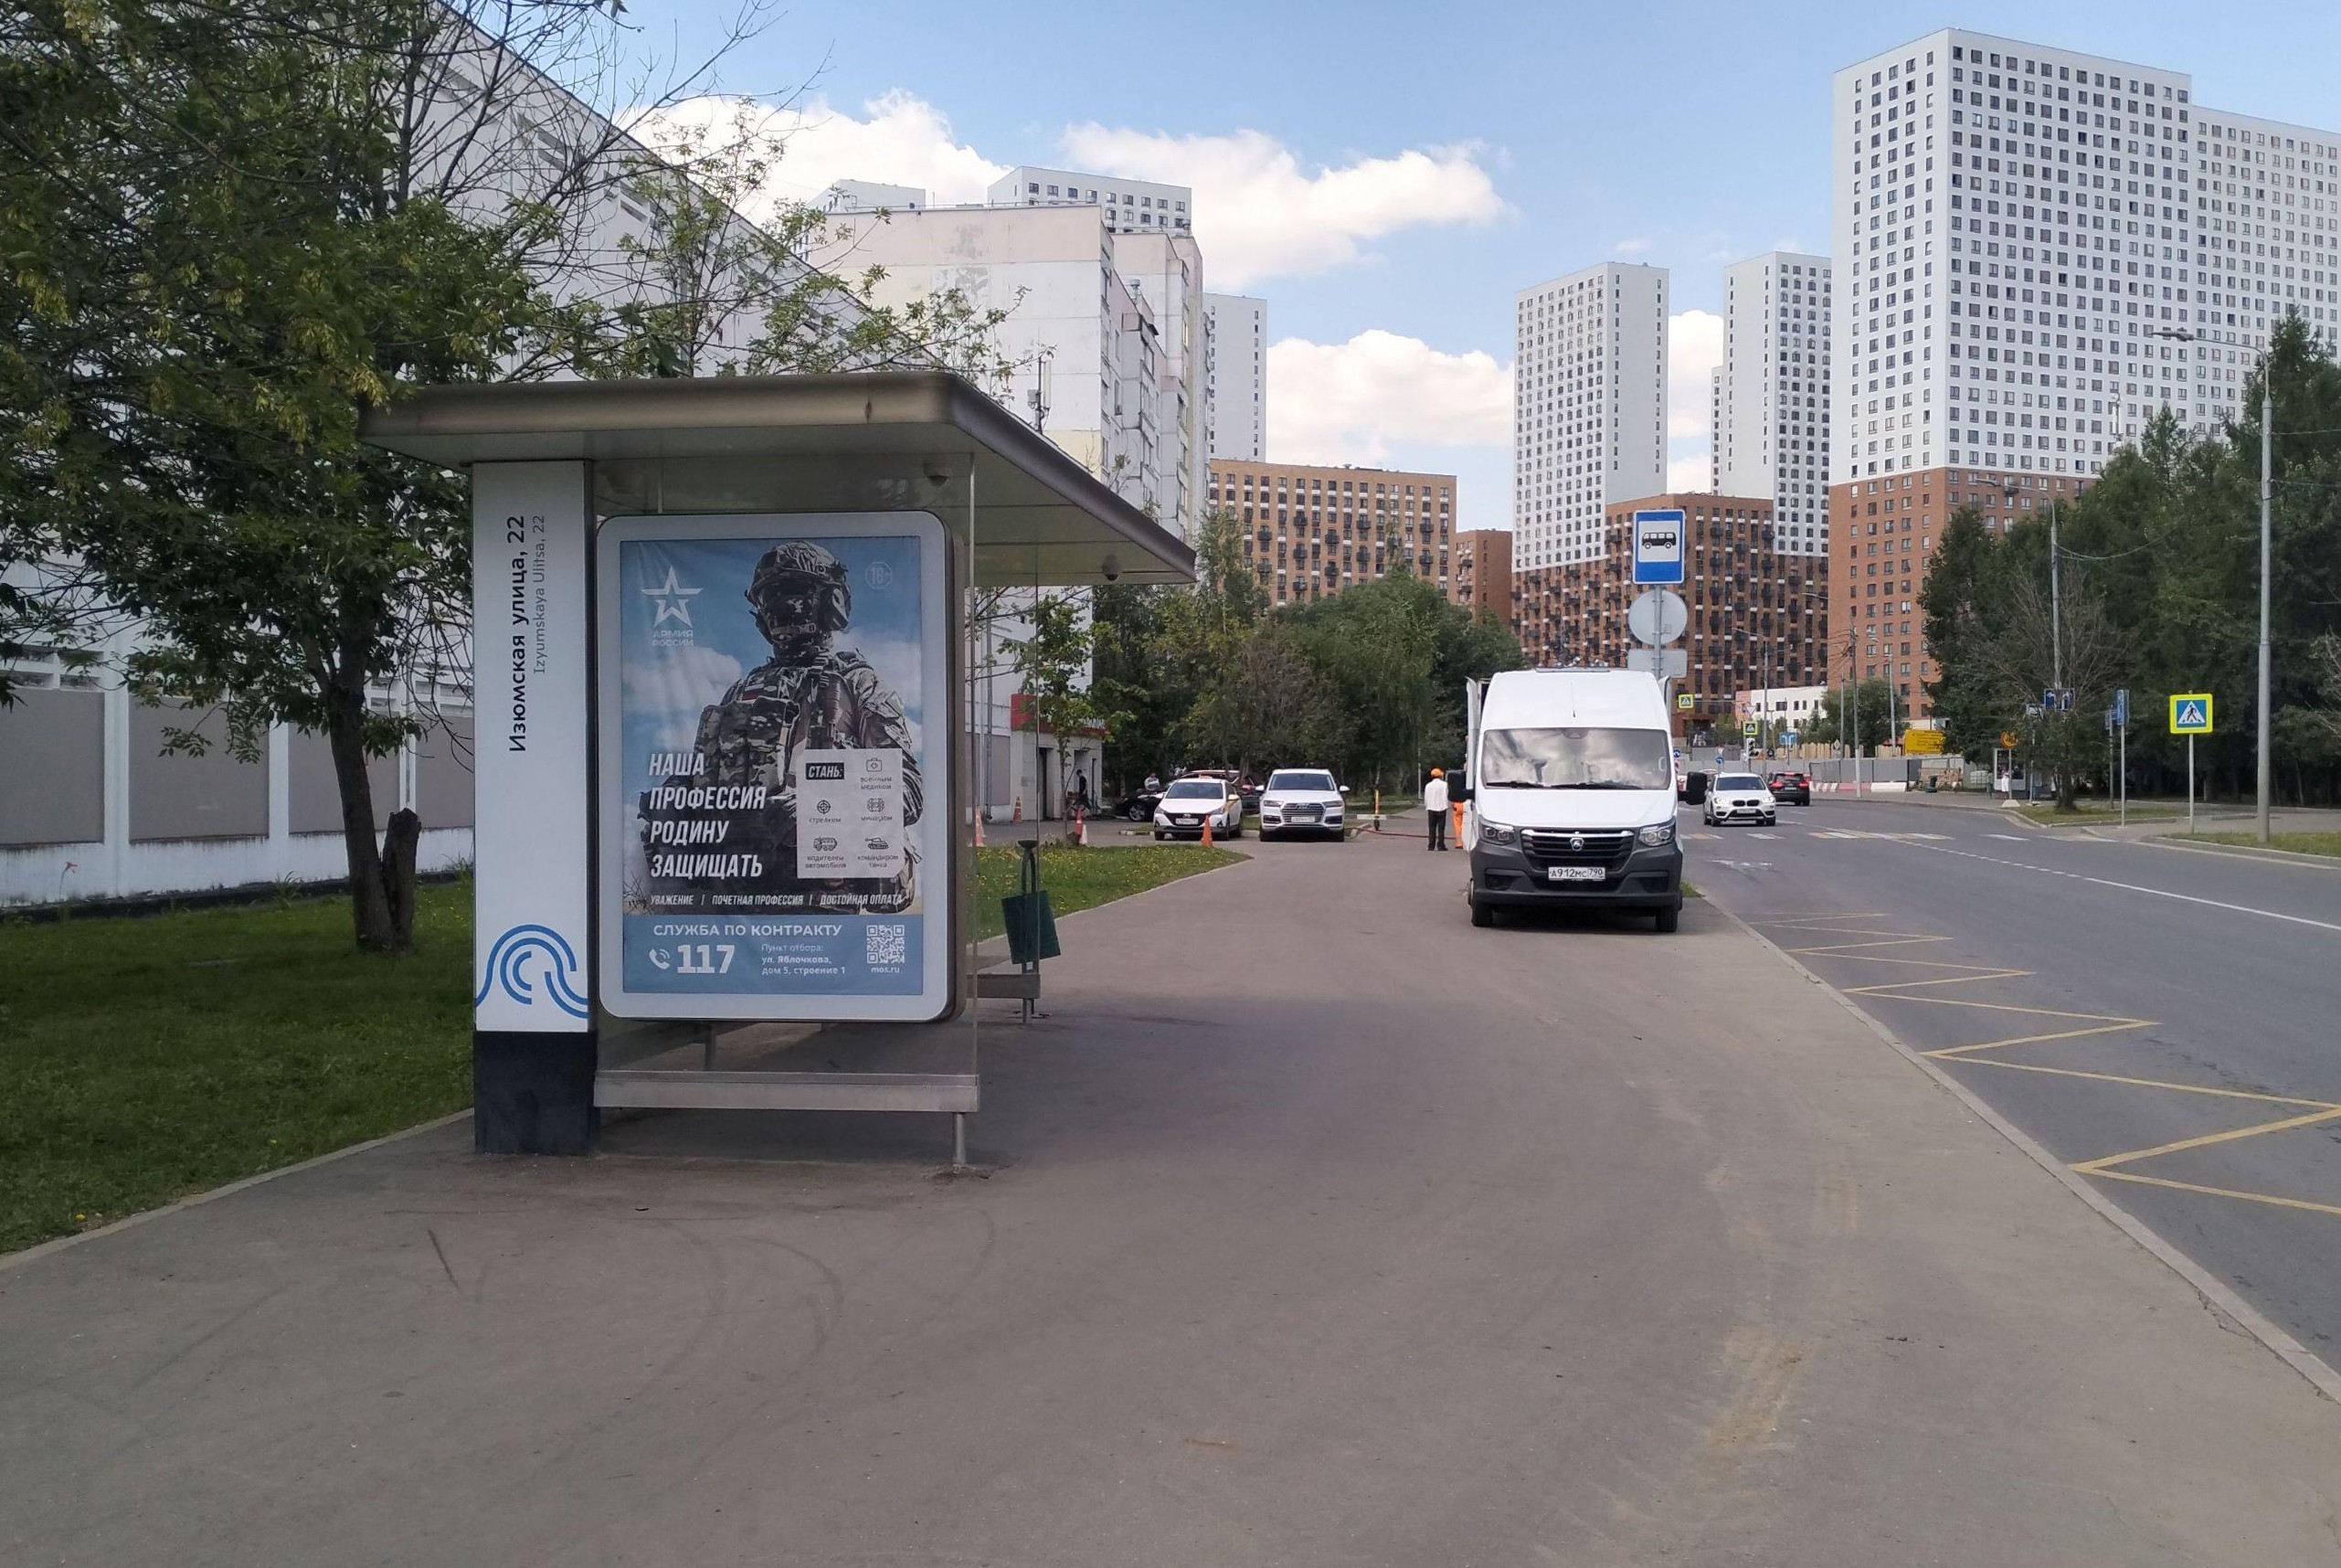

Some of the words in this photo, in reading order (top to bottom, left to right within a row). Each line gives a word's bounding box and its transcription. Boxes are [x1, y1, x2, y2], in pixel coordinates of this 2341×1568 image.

[507, 515, 524, 544] 22
[533, 514, 545, 534] 22
[533, 538, 546, 583] Ulitsa,
[512, 551, 529, 626] улица,
[533, 588, 548, 673] Izyumskaya
[652, 630, 694, 638] АРМИЯ
[652, 639, 694, 647] РОССИИ
[508, 635, 526, 752] Изюмская
[649, 753, 704, 776] НАША
[809, 765, 843, 779] СТАНЬ:
[649, 787, 768, 810] ПРОФЕССИЯ
[650, 821, 729, 846] РОДИНУ
[650, 854, 763, 880] ЗАЩИЩАТЬ
[650, 895, 694, 906] УВАЖЕНИЕ
[712, 895, 753, 906] ПОЧЕТНАЯ
[754, 895, 804, 906] ПРОФЕССИЯ
[820, 893, 868, 906] ДОСТОЙНАЯ
[869, 895, 902, 905] ОПЛАТА
[653, 925, 720, 936] СЛУЖБА
[725, 925, 747, 936] ПО
[751, 925, 842, 937] КОНТРАКТУ
[761, 944, 787, 953] Пункт
[789, 943, 823, 953] отбора:
[677, 944, 736, 974] 117
[761, 957, 775, 966] ул.
[778, 956, 832, 966] Яблочкова,
[761, 967, 781, 976] дом
[783, 966, 791, 975] 5,
[793, 967, 839, 977] строение
[871, 966, 900, 974] mos.ru
